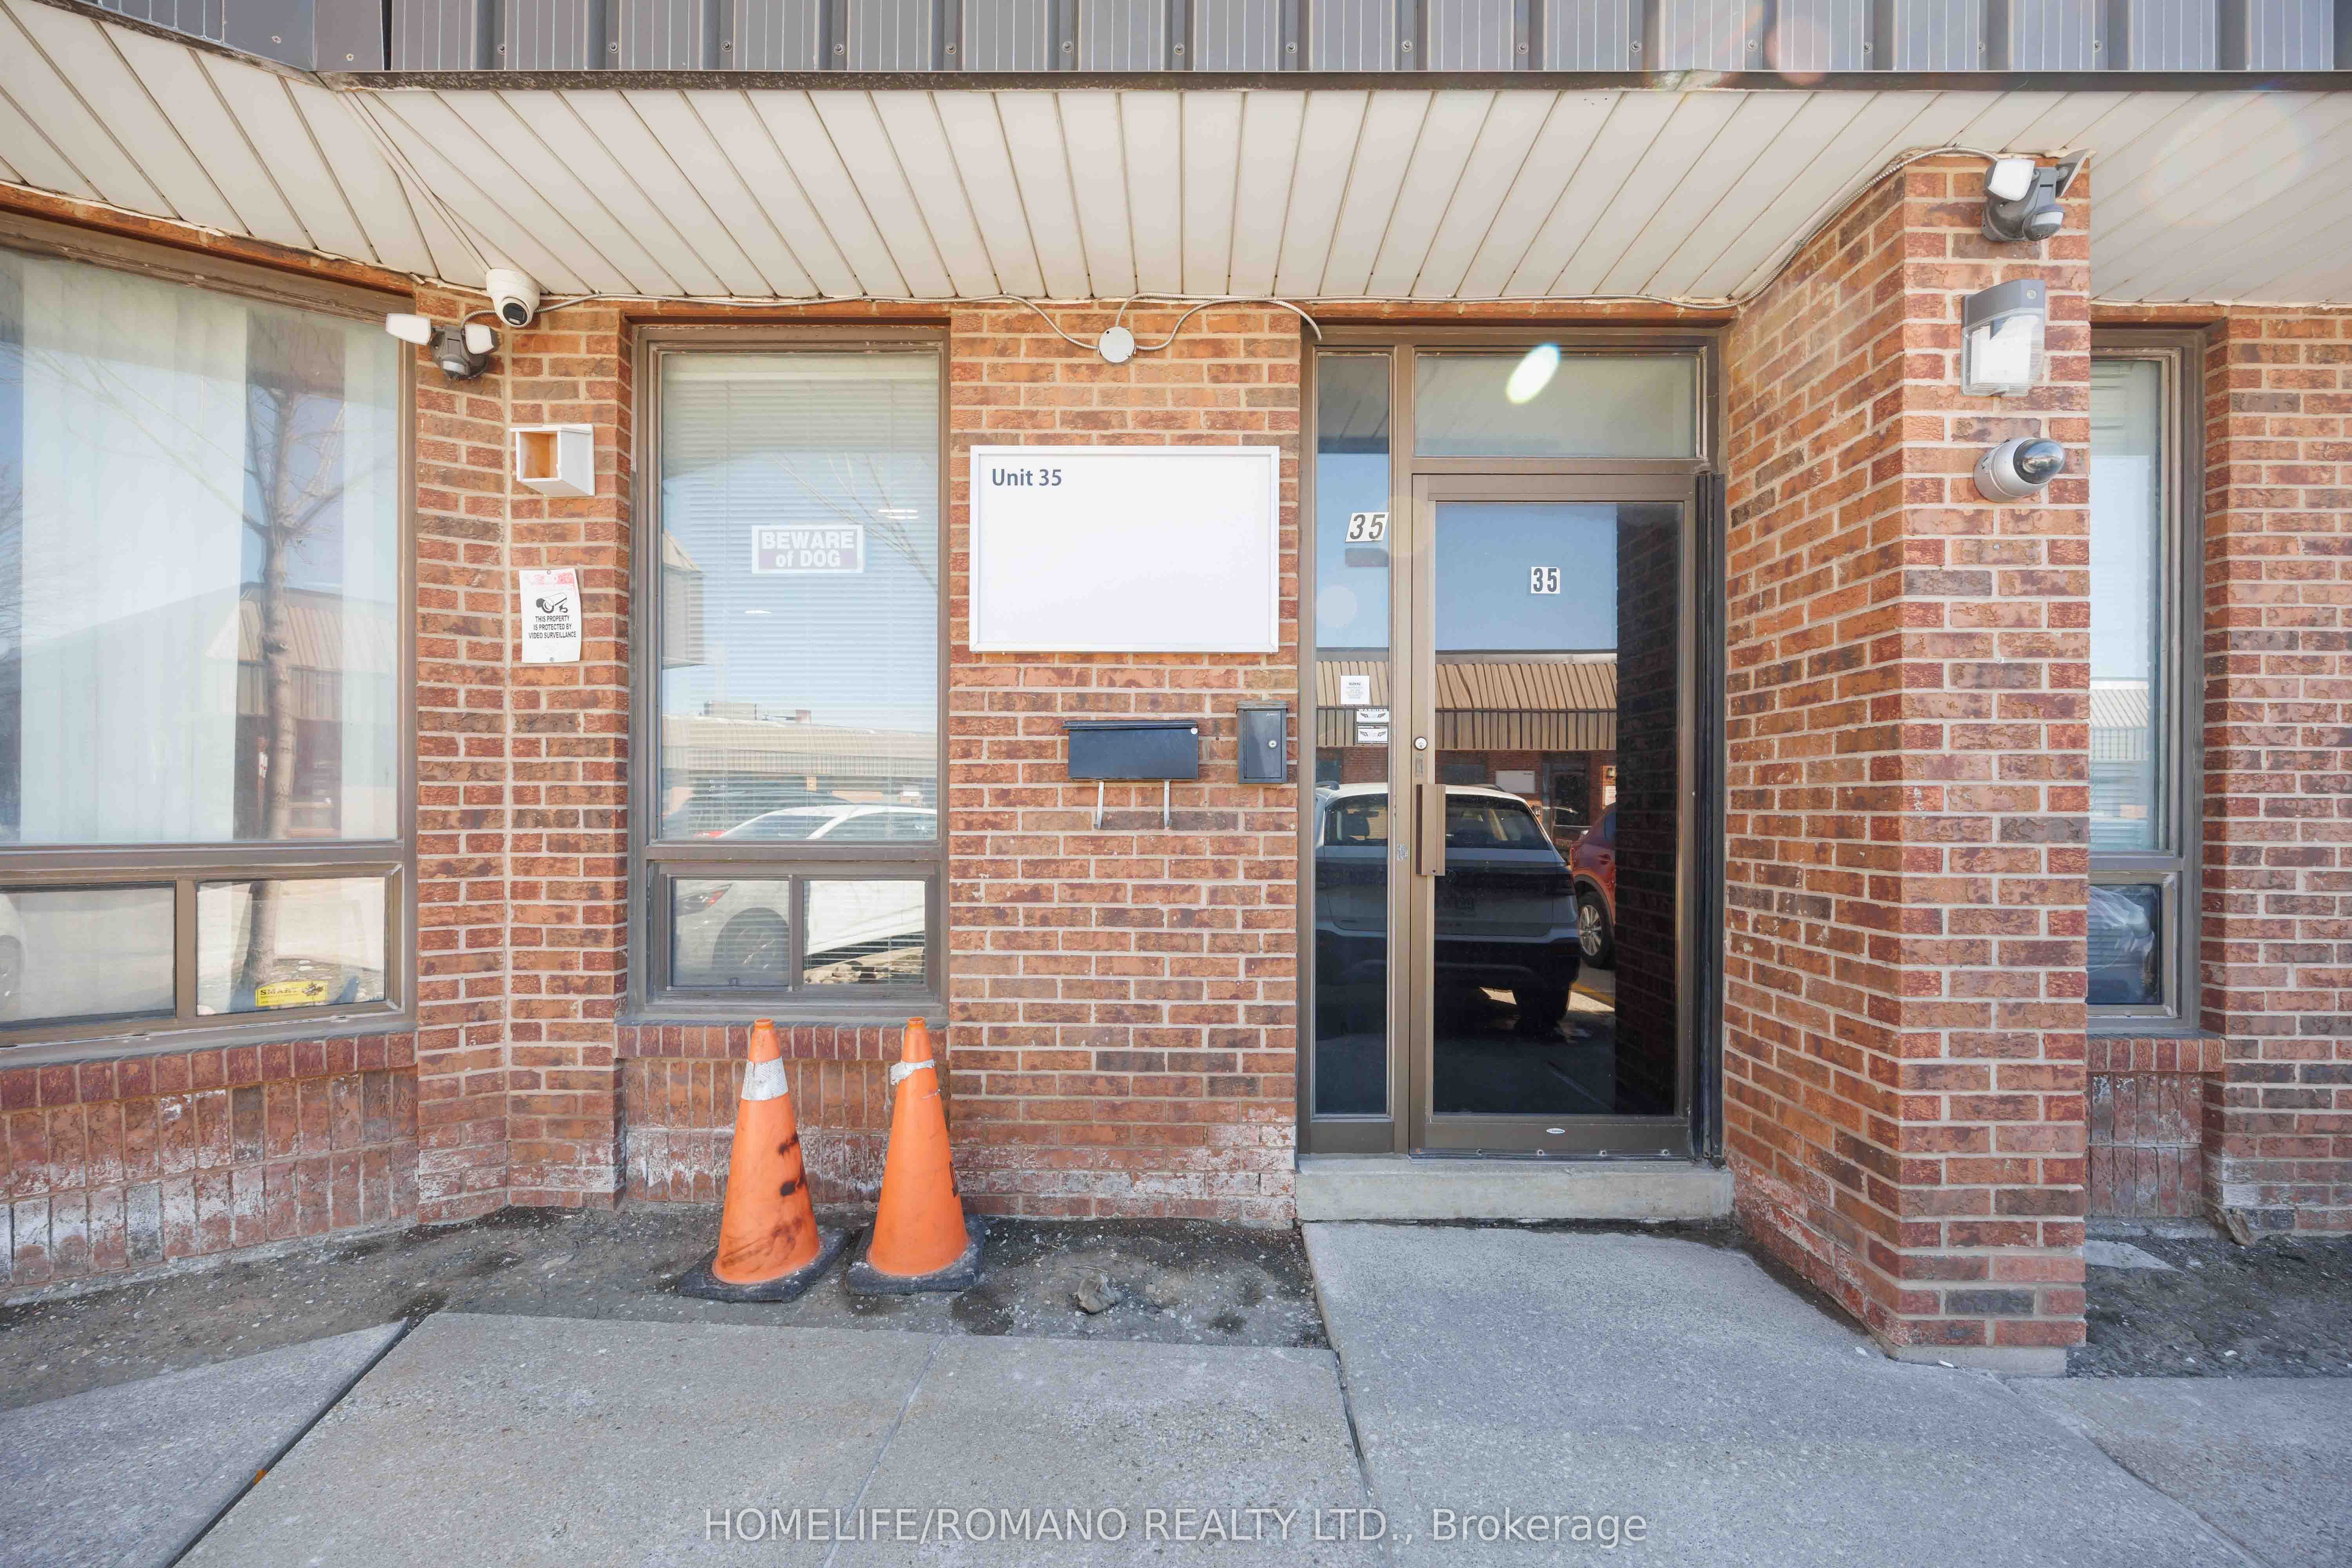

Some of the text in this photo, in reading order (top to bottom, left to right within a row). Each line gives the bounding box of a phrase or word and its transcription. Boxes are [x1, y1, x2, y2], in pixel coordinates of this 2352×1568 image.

[992, 468, 1062, 486] Unit 35
[1350, 514, 1385, 540] 35
[762, 531, 854, 549] BEWARE
[775, 550, 841, 567] of DOG
[1533, 568, 1558, 592] 35
